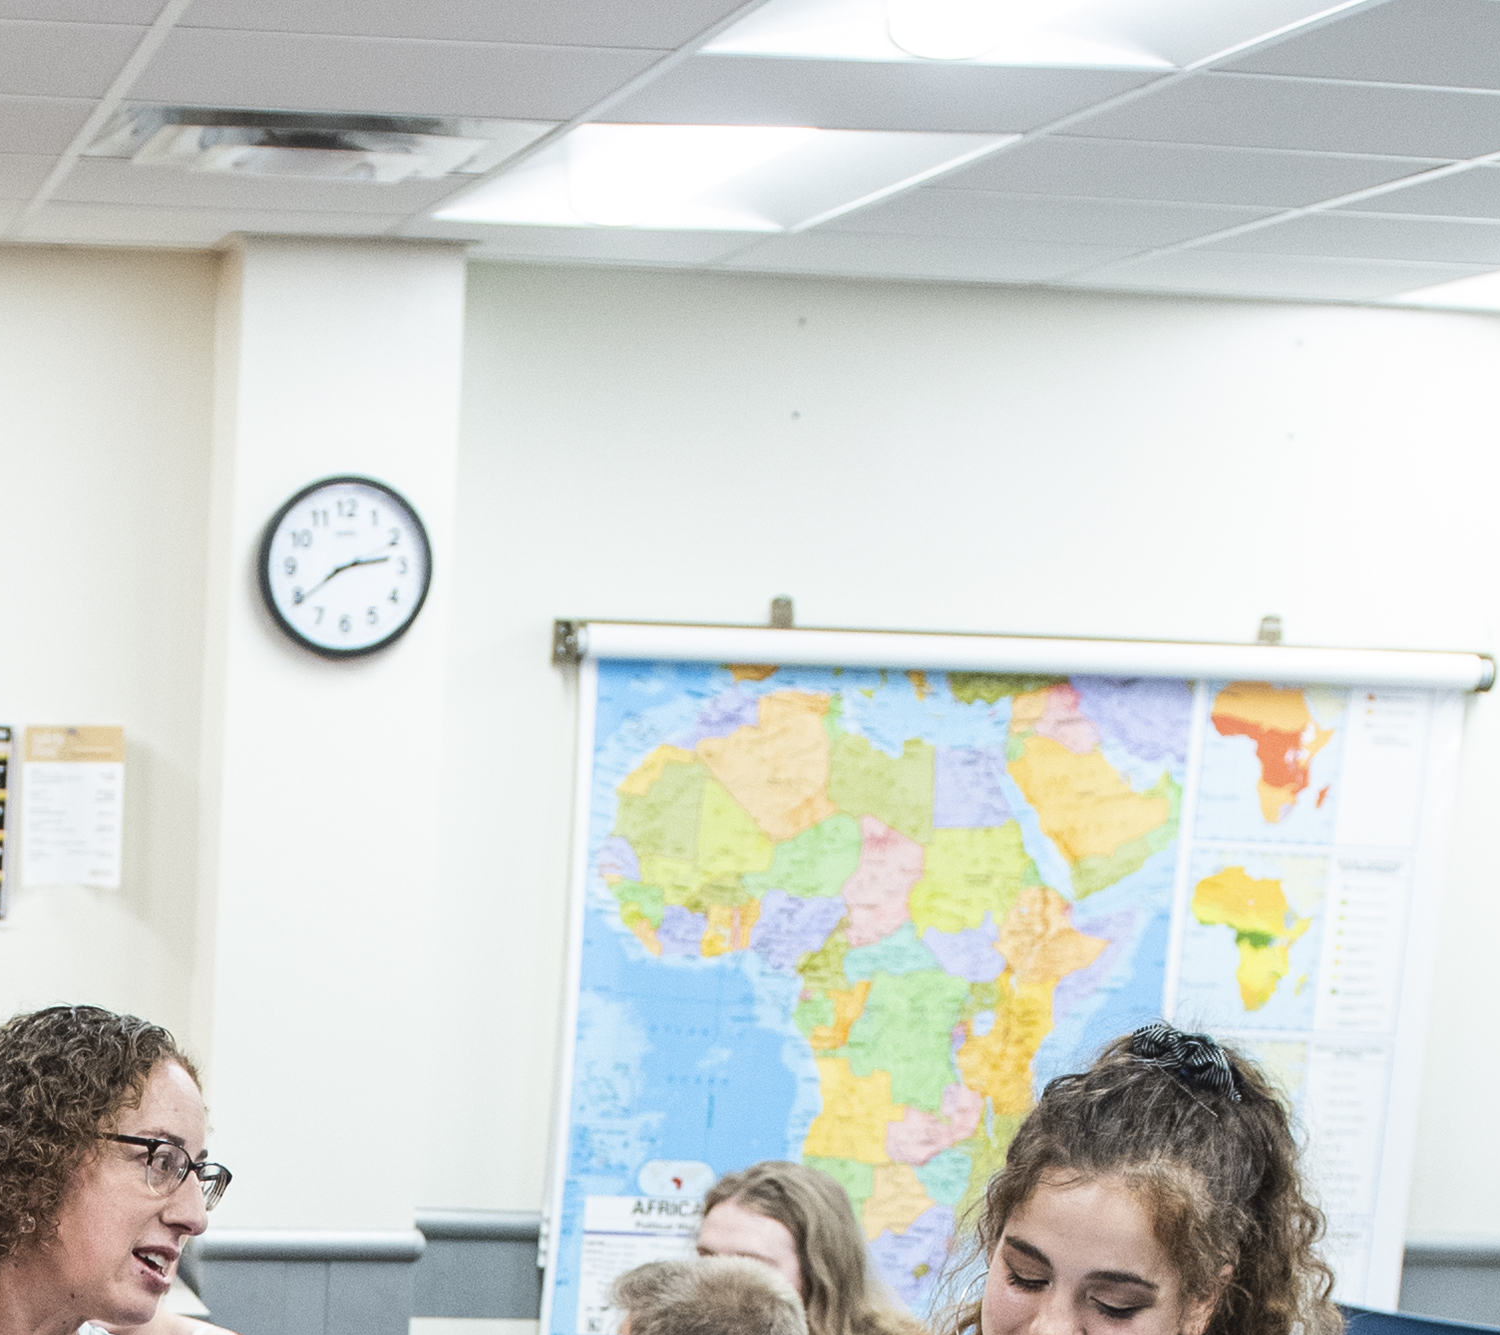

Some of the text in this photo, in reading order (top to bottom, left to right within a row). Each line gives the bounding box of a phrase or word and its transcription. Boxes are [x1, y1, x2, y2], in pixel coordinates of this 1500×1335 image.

[311, 509, 329, 527] 11
[336, 499, 358, 518] 12
[371, 509, 379, 527] 1
[291, 529, 313, 549] 10
[389, 528, 401, 547] 2
[284, 556, 298, 577] 9
[399, 556, 408, 576] 3
[388, 588, 400, 605] 4
[314, 606, 325, 625] 7
[339, 615, 351, 635] 6
[367, 606, 379, 626] 5
